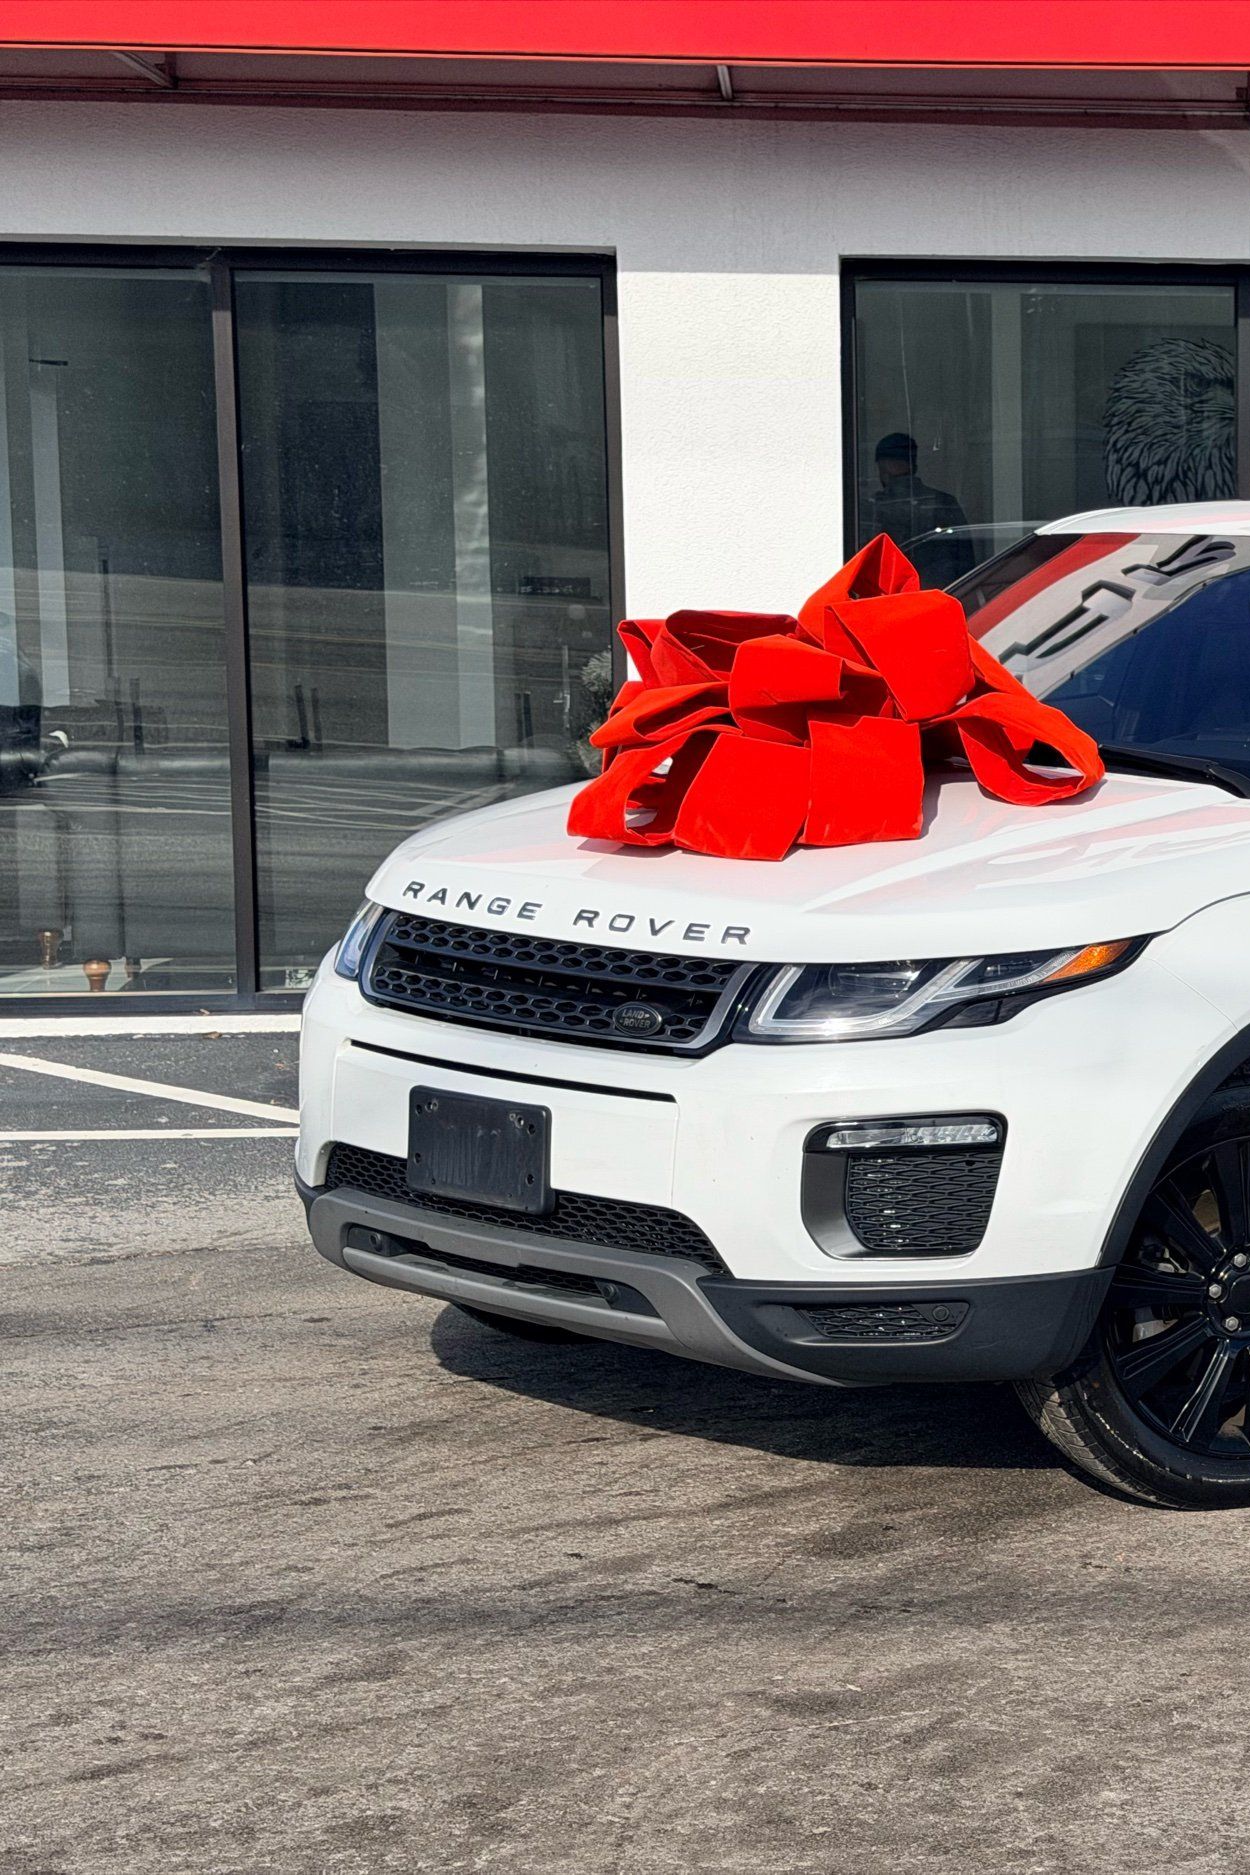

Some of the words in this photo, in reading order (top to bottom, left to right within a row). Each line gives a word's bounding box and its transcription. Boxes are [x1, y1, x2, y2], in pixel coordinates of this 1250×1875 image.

[402, 880, 543, 921] RANGE
[572, 908, 751, 946] ROVER
[621, 1008, 645, 1020] LAND
[623, 1017, 651, 1029] ROVER
